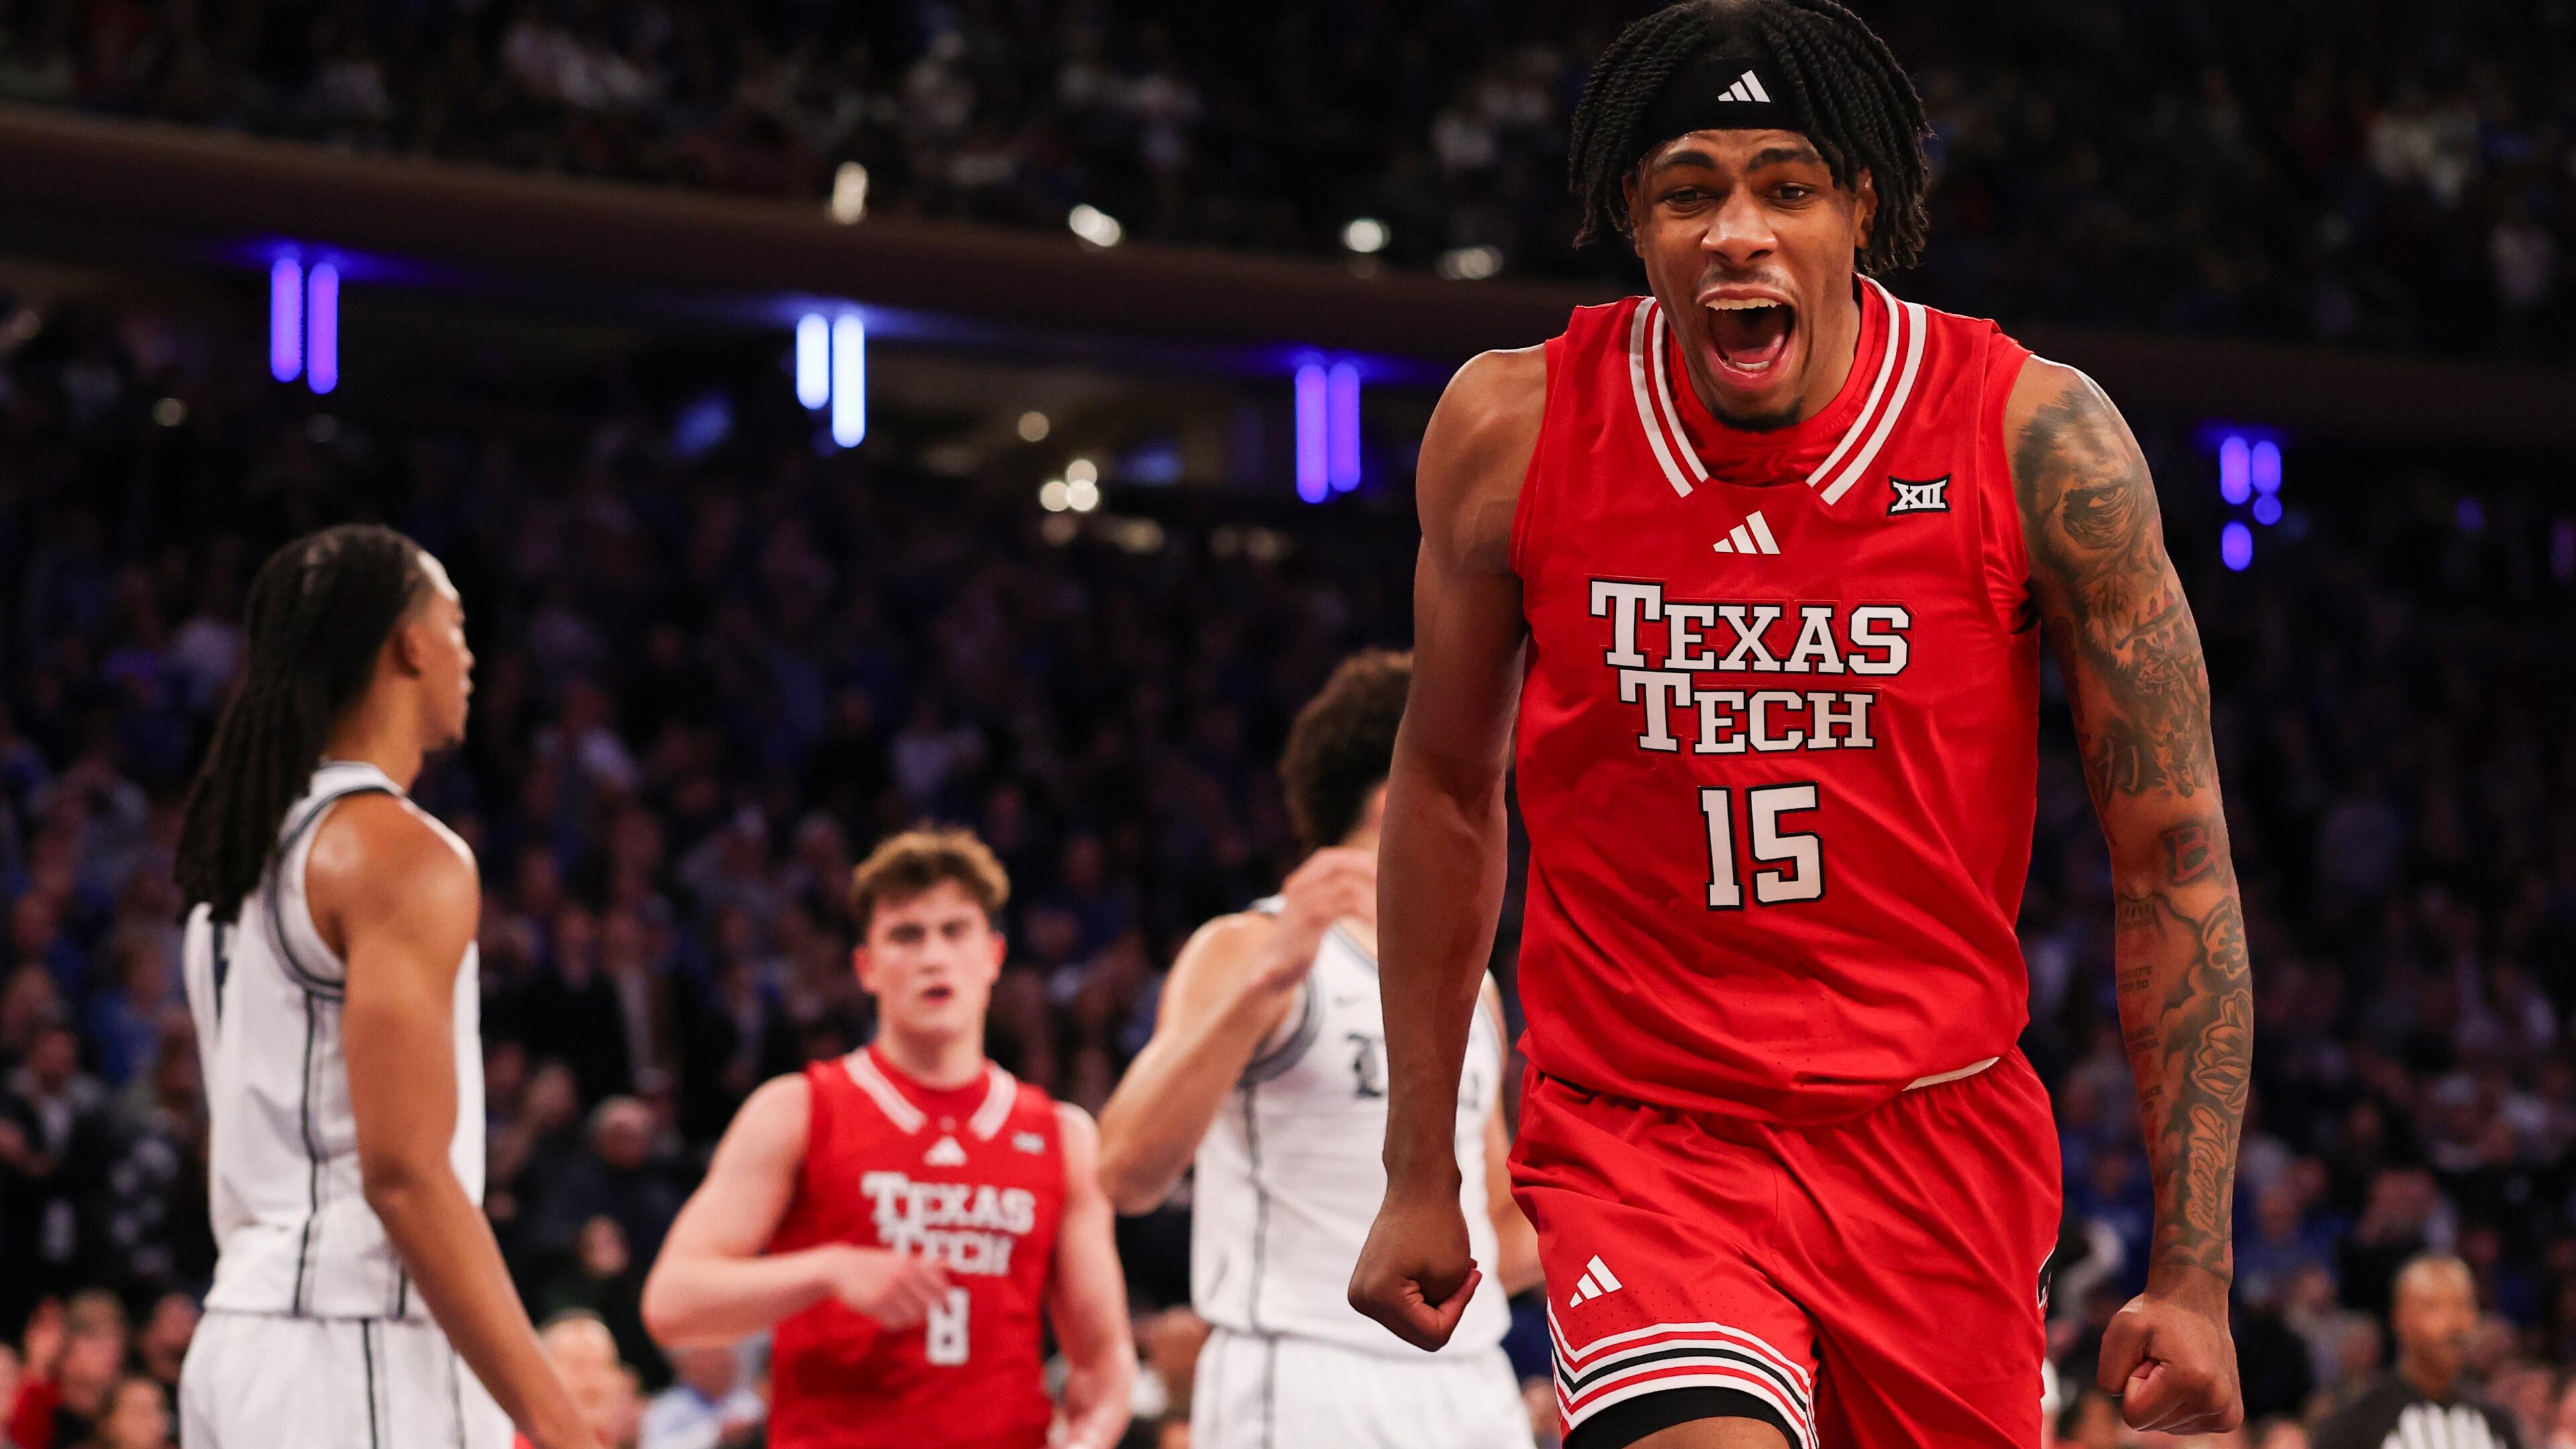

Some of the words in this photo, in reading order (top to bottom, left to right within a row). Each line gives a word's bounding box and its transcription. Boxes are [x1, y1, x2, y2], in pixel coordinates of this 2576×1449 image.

[1889, 478, 1949, 514] XII
[1589, 578, 1913, 676] TEXAS
[1617, 668, 1876, 755] TECH
[1698, 782, 1825, 910] 15
[861, 1171, 1036, 1234] TEXAS
